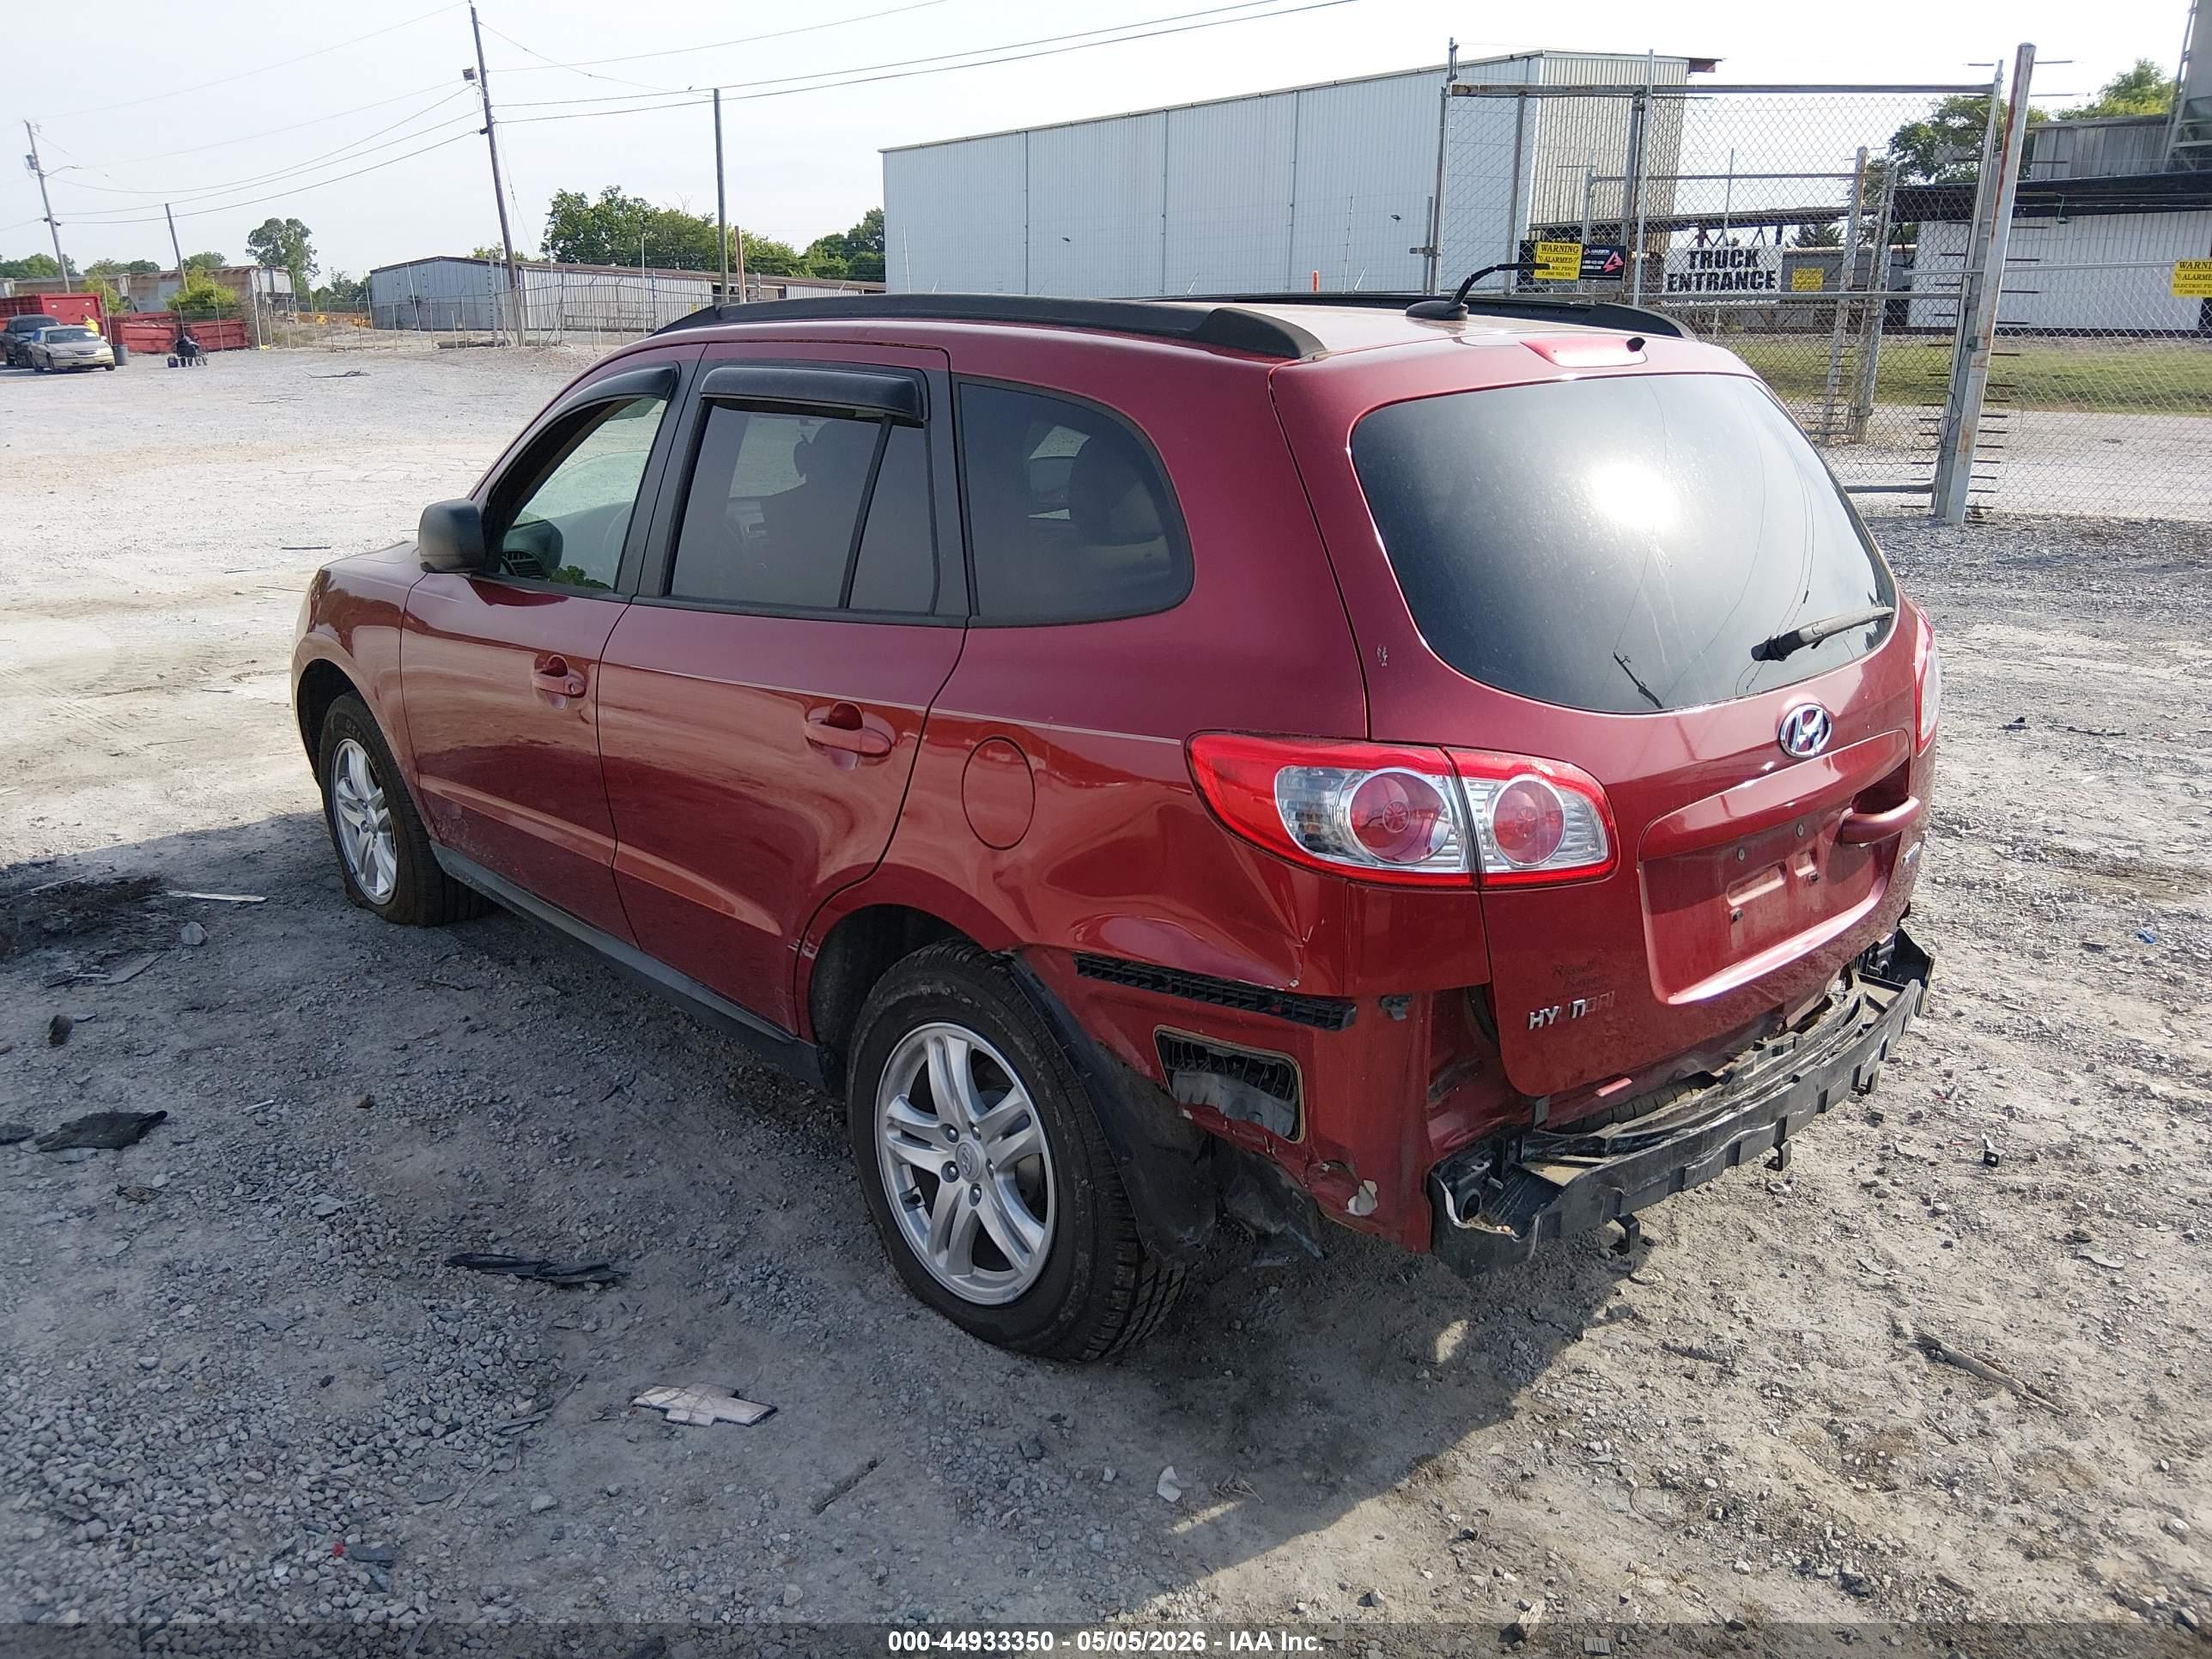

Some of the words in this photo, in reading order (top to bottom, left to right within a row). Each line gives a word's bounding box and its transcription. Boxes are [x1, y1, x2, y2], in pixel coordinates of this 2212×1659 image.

[1541, 244, 1579, 254] WARNING
[1546, 255, 1573, 264] ALARMED
[1687, 248, 1760, 270] TRUCK
[1667, 270, 1777, 292] ENTRANCE
